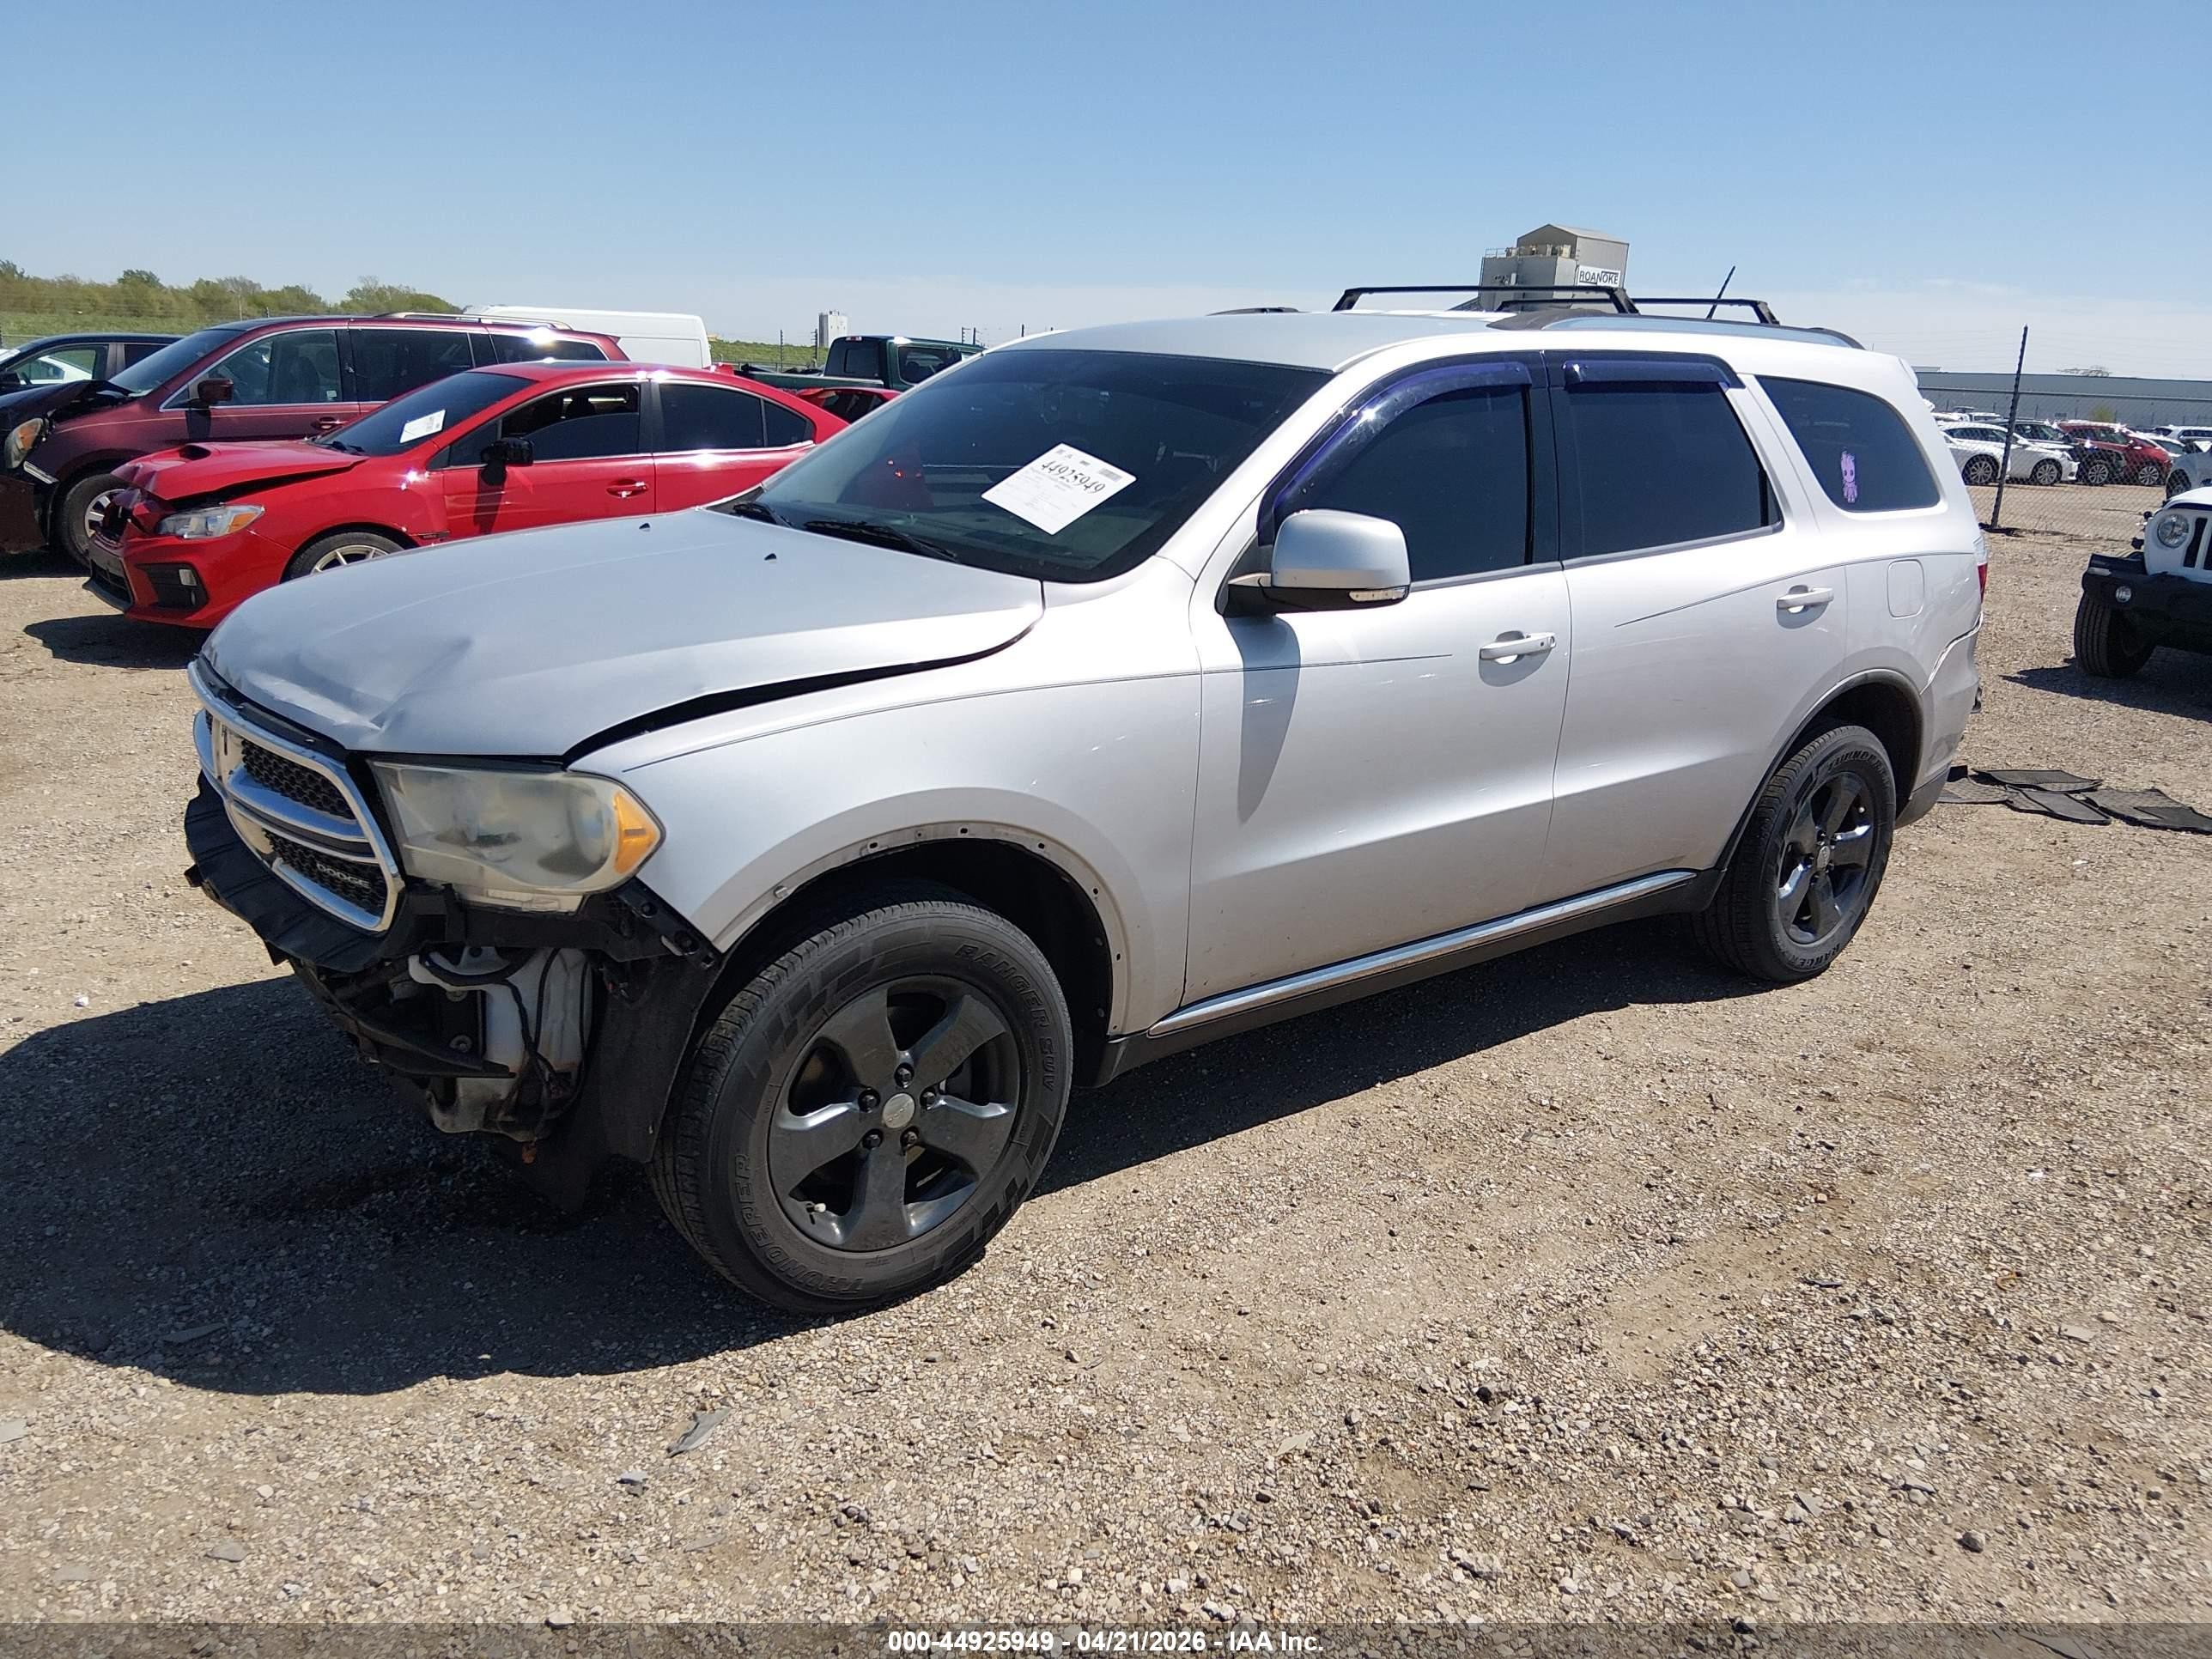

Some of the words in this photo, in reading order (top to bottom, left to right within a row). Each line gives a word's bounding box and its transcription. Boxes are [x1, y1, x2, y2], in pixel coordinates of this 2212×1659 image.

[1580, 270, 1619, 285] ROANOKE
[1041, 459, 1106, 495] 44925949
[316, 862, 372, 890] DODGE
[954, 944, 1051, 1029] RANGER
[1039, 1036, 1054, 1092] SUV
[734, 1153, 865, 1295] THUNDERER
